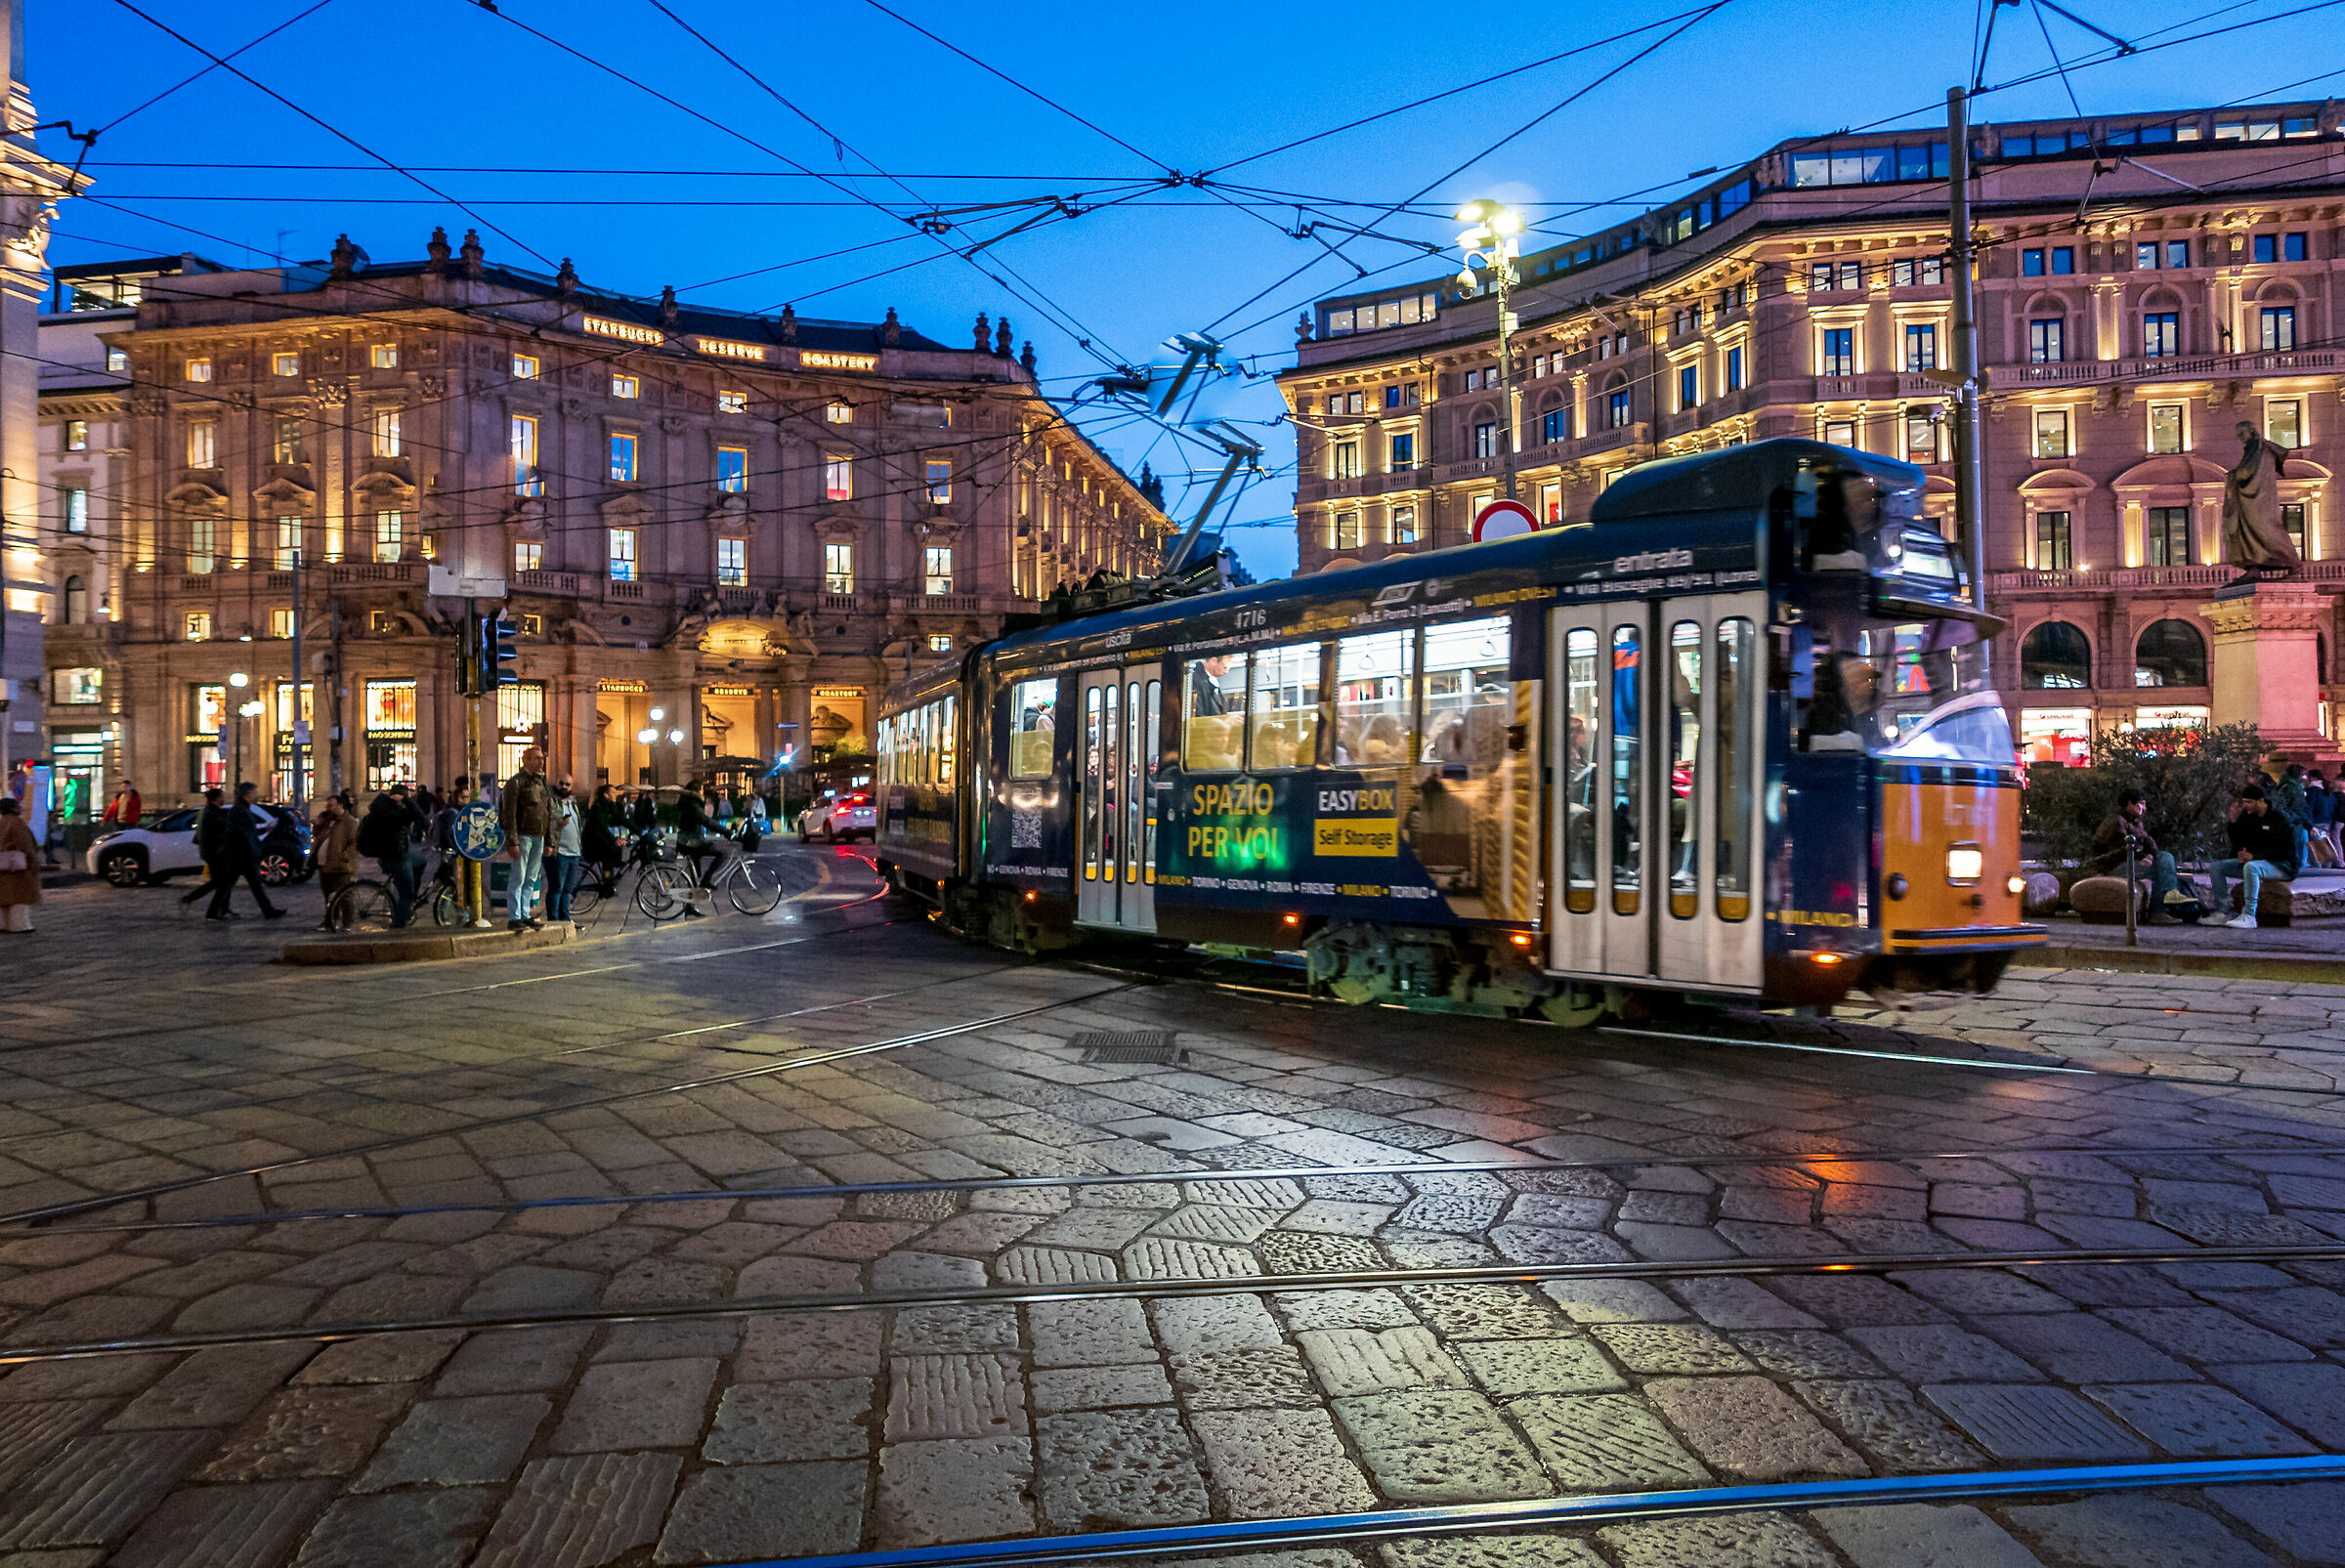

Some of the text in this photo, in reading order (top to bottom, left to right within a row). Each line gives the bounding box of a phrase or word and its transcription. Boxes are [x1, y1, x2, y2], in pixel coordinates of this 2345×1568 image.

[583, 318, 876, 370] STARBUCKS RESERVE ROASTERY
[1614, 548, 1693, 573] entrata
[1234, 609, 1266, 628] 4716
[1105, 632, 1131, 648] uscita
[601, 684, 644, 693] STARBUCKS
[1192, 783, 1274, 817] SPAZIO
[1318, 788, 1394, 812] EASYBOX
[1187, 826, 1278, 860] PER VOI
[1318, 828, 1392, 850] Self Storage
[1157, 874, 1186, 886] MILANO
[1192, 876, 1219, 888] TORINO
[1226, 878, 1259, 891] GENOVA
[1266, 880, 1294, 893] ROMA
[1300, 881, 1336, 895] FIRENZE
[1343, 883, 1382, 897] MILANO
[1388, 885, 1429, 899] TORINO
[1778, 910, 1855, 927] MILANO
